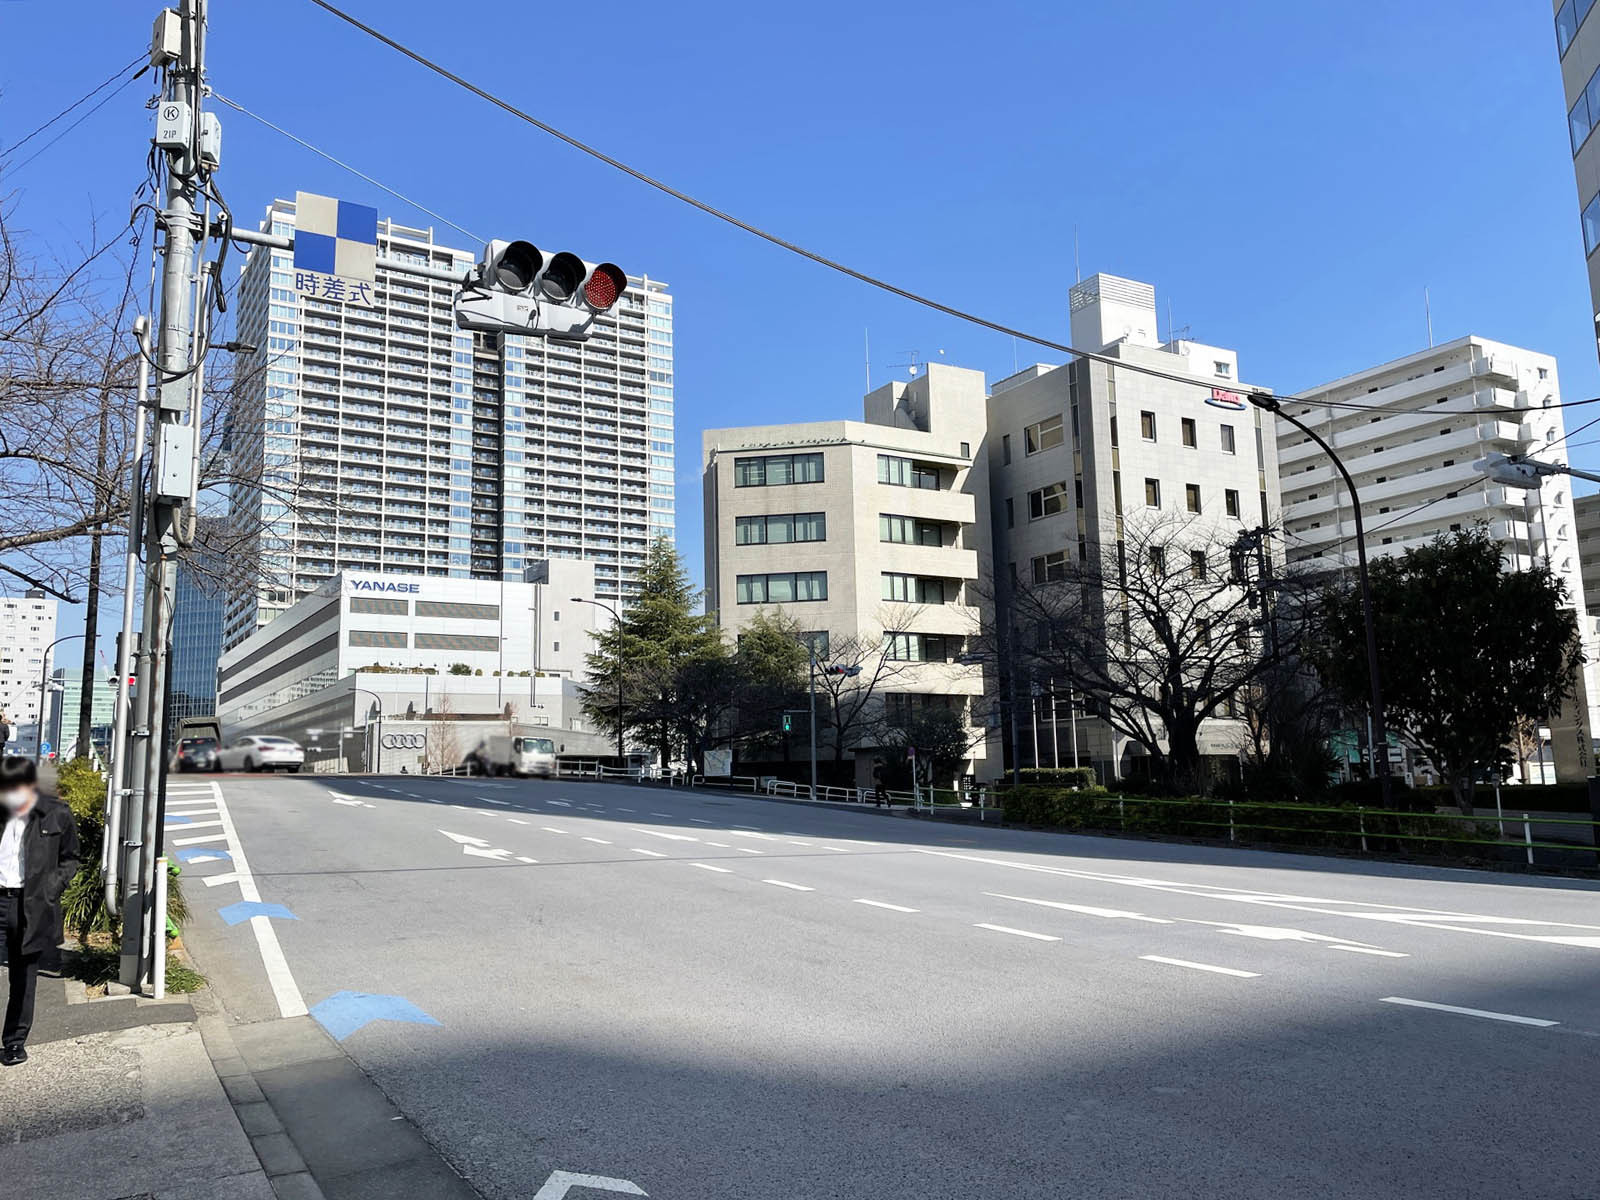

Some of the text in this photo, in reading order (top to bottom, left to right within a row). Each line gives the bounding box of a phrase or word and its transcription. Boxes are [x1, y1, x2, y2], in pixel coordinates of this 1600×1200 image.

[295, 272, 372, 306] 時差式
[350, 580, 420, 594] YANASE
